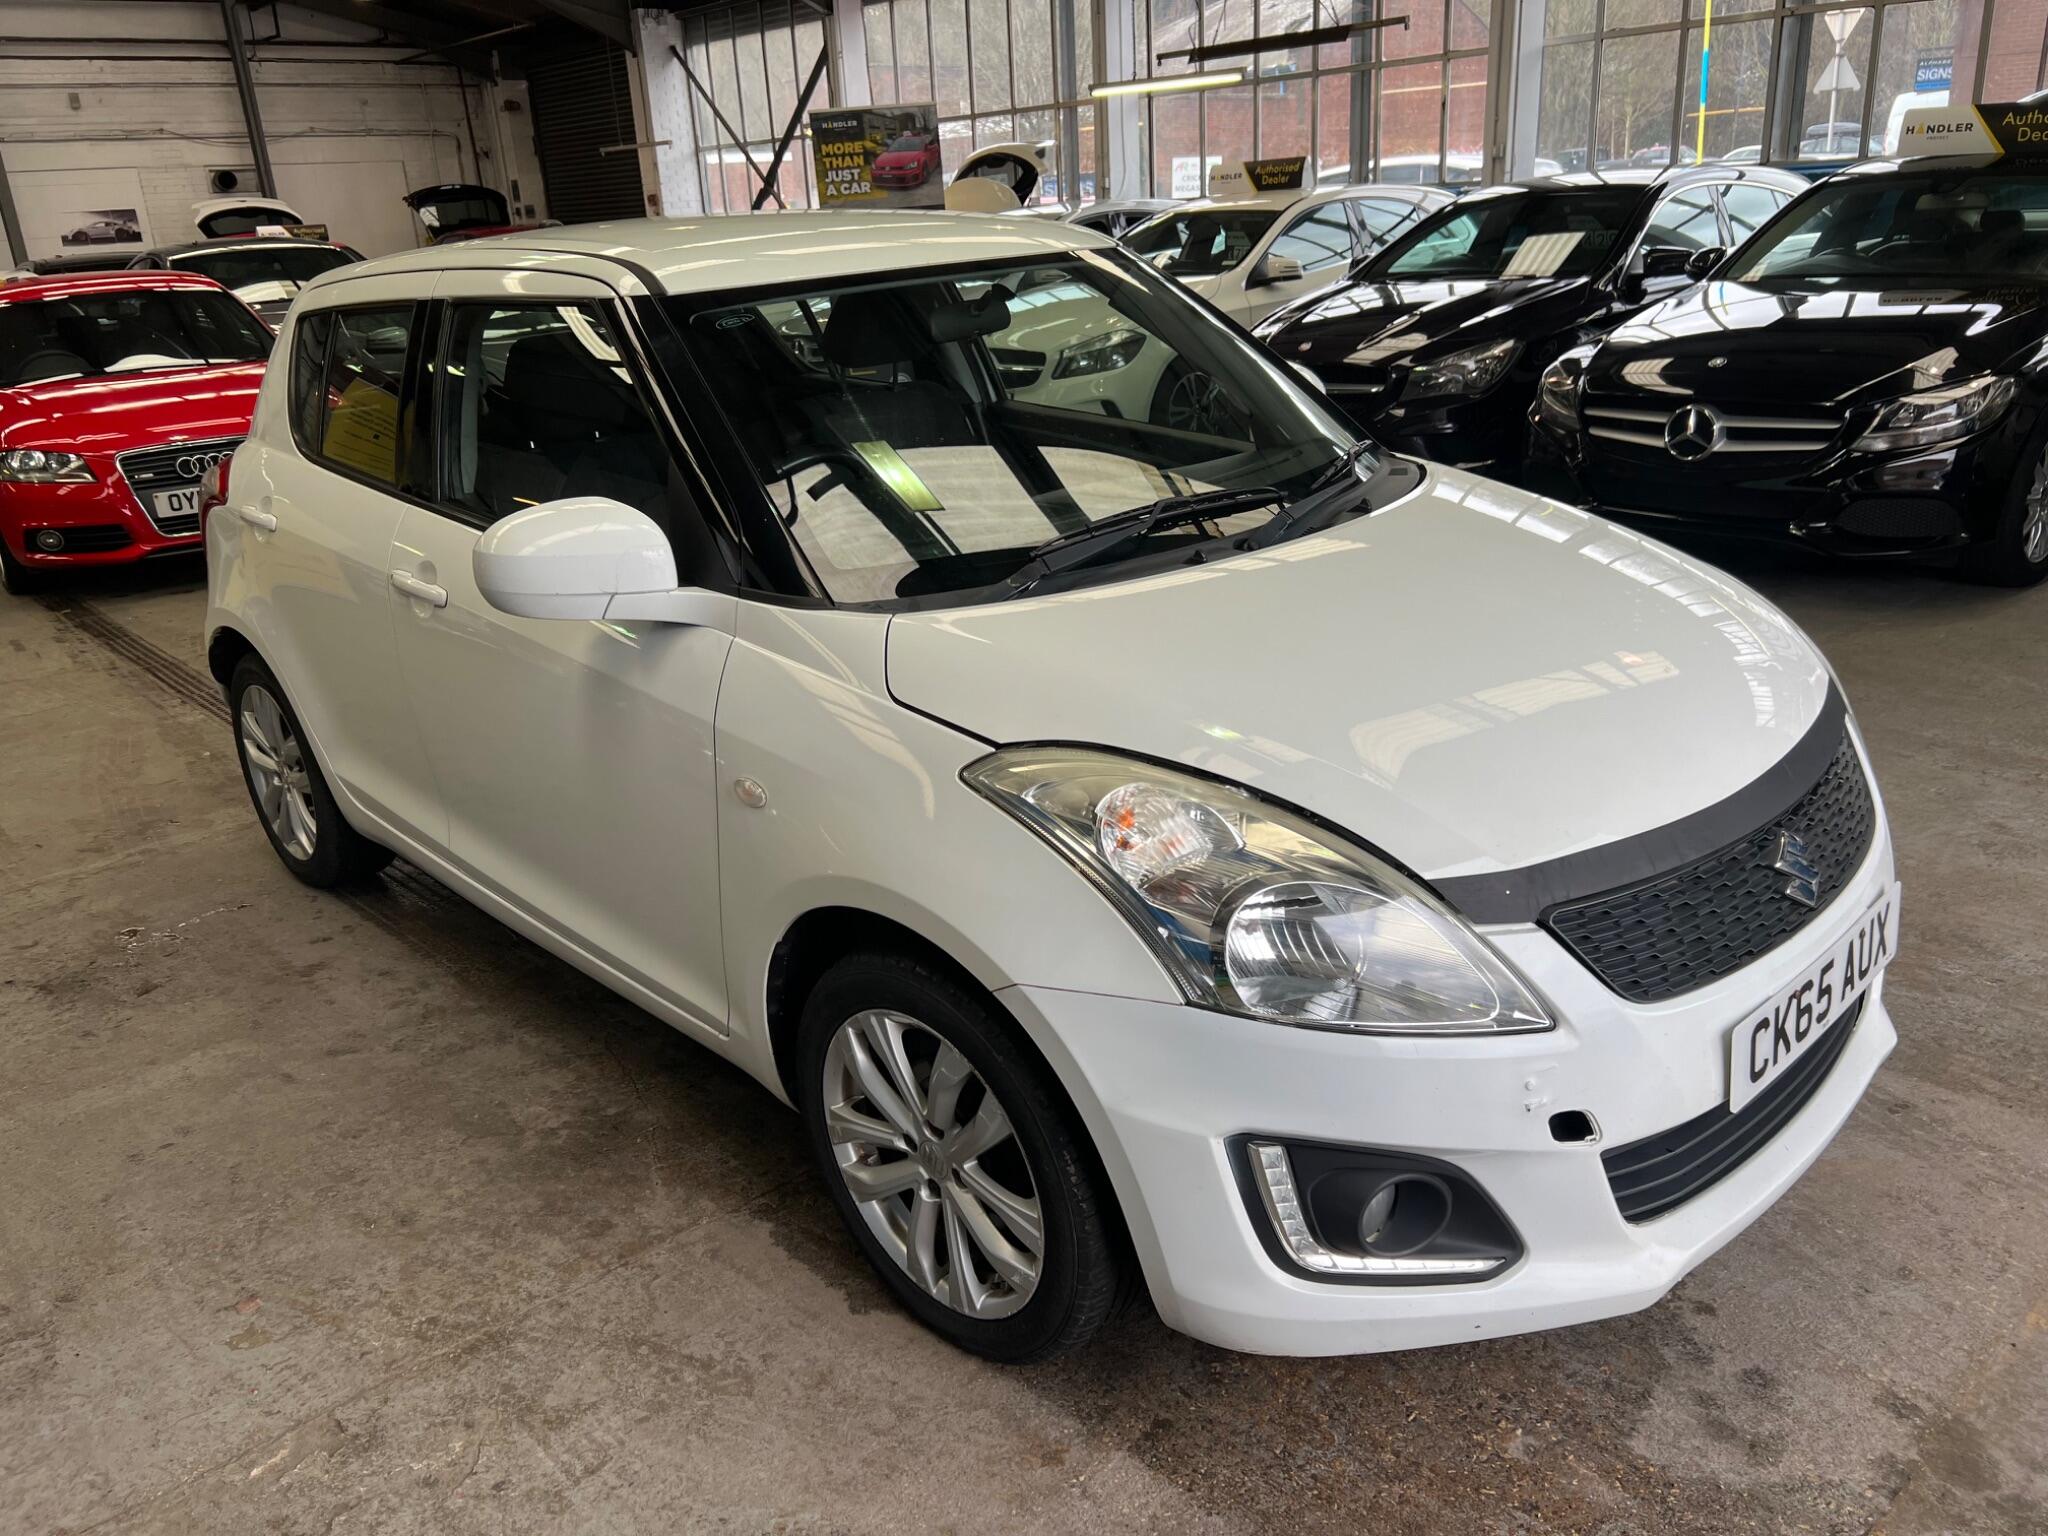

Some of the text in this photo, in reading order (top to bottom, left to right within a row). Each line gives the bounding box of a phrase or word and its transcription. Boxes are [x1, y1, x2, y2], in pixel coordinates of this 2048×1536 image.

[821, 142, 864, 156] MORE
[822, 156, 865, 169] THAN
[1255, 162, 1301, 175] Authorised
[825, 169, 861, 182] JUST
[1262, 173, 1289, 185] Dealer
[826, 182, 871, 197] A CAR
[168, 490, 200, 512] OY
[1750, 902, 1890, 1084] CK65 AUX
